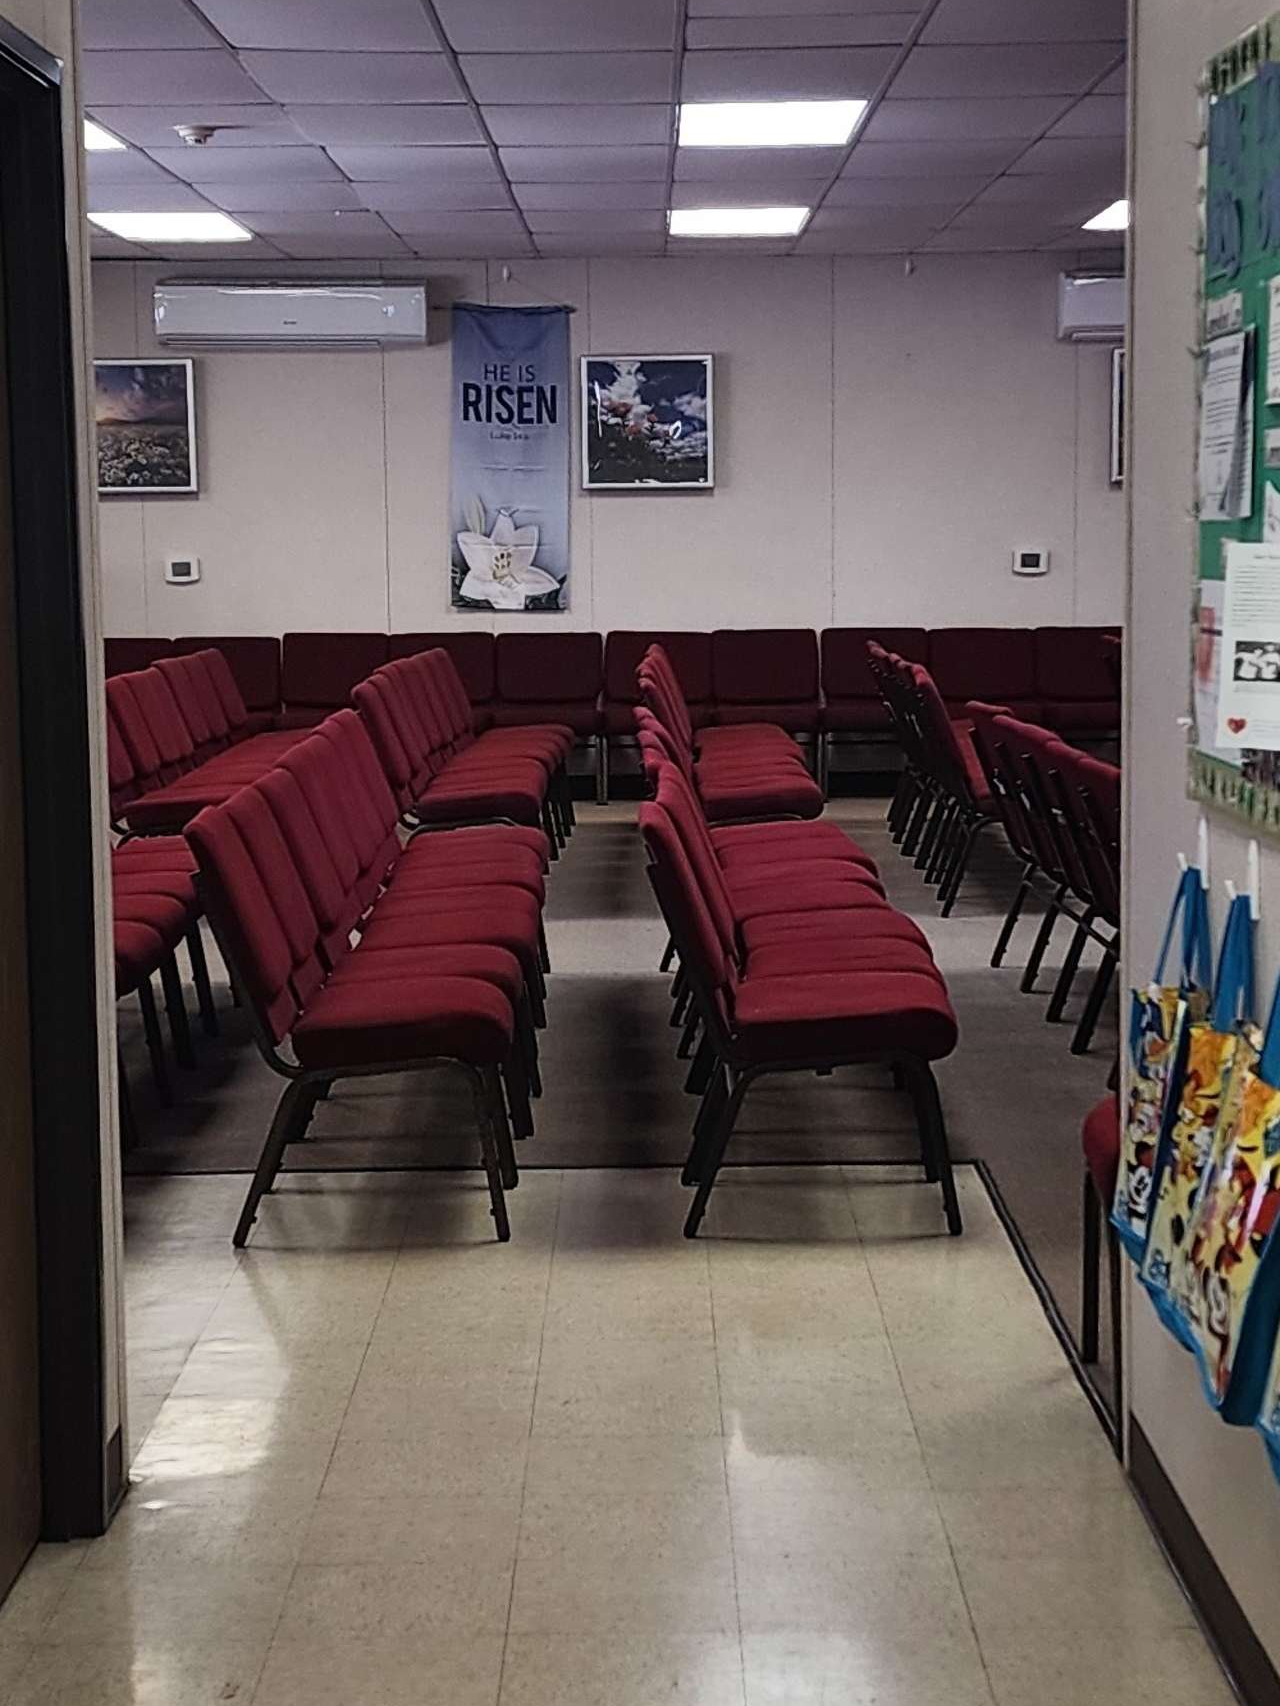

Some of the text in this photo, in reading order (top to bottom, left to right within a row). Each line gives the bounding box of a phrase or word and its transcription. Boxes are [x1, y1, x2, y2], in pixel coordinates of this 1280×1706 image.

[483, 363, 535, 383] HE IS
[462, 382, 557, 425] RISEN
